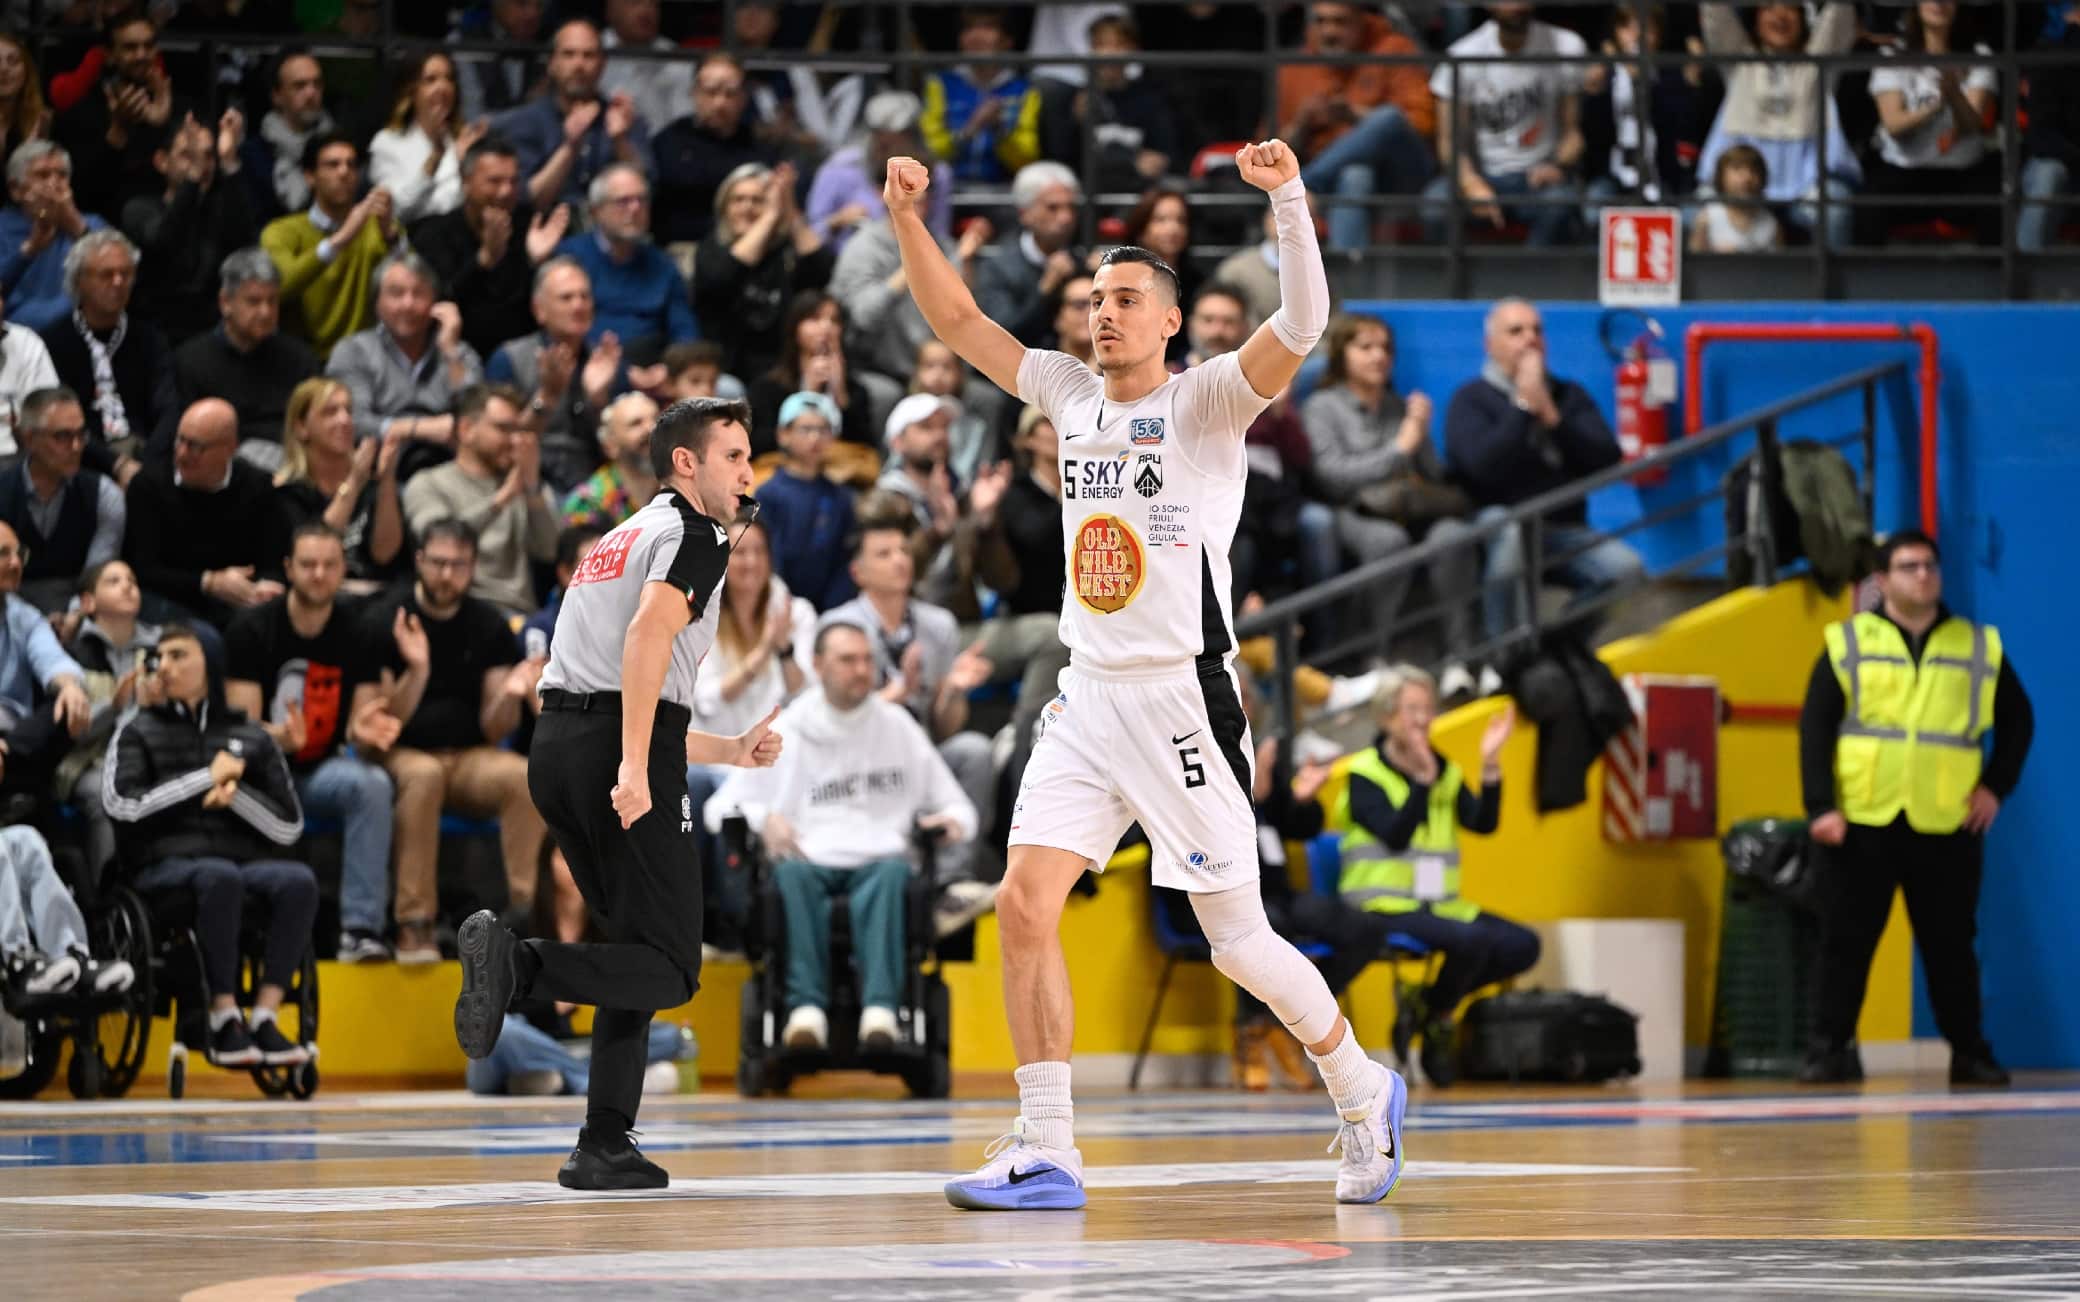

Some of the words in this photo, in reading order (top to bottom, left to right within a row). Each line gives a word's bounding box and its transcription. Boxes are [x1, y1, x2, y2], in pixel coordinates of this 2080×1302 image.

[1138, 453, 1161, 465] APU
[1064, 459, 1078, 499] 5
[1082, 461, 1127, 485] SKY
[1082, 486, 1124, 499] ENERGY
[1161, 504, 1190, 514] SONO
[1148, 514, 1174, 523] FRIULI
[1148, 524, 1186, 532] VENEZIA
[1084, 527, 1121, 550] OLD
[1148, 533, 1178, 542] GIULIA
[1081, 550, 1128, 574] WILD
[1079, 573, 1132, 597] WEST
[1178, 747, 1206, 789] 5
